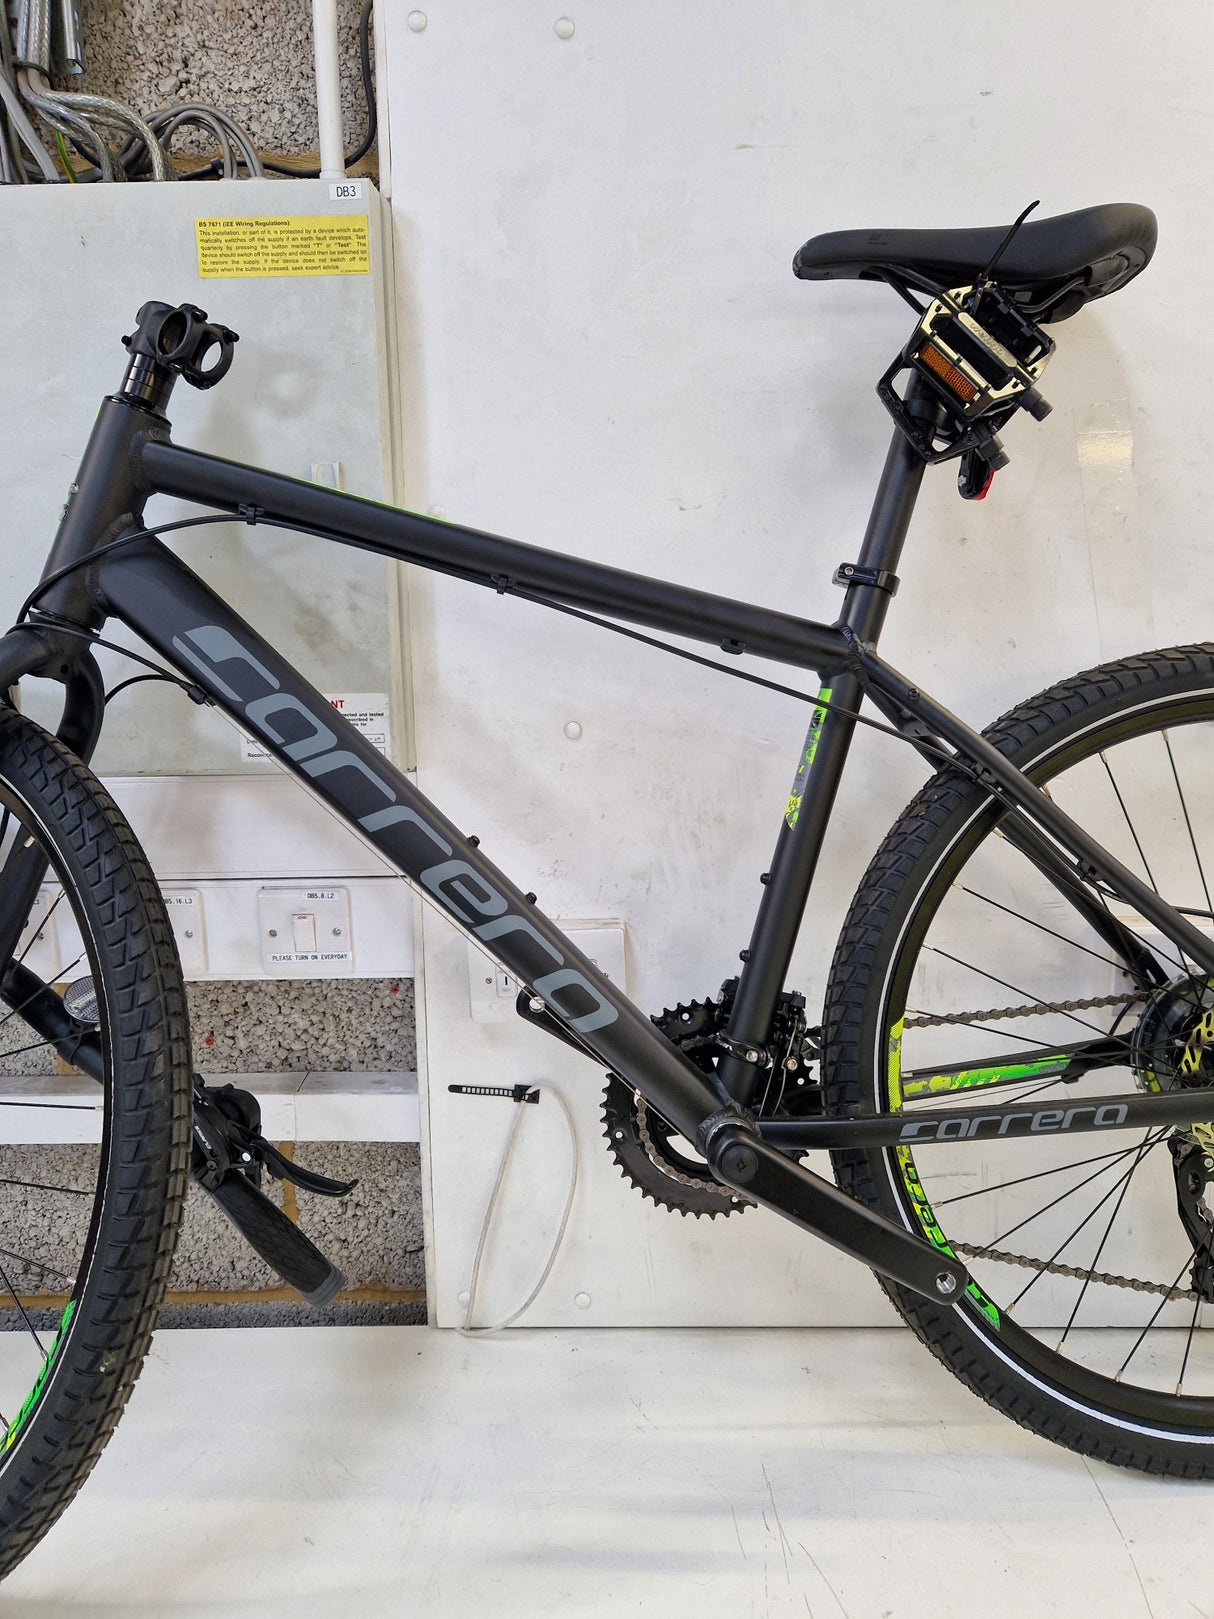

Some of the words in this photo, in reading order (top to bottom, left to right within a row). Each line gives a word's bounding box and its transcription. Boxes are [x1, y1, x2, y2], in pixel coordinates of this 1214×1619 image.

[336, 186, 356, 197] DB3
[172, 625, 618, 1033] carrera
[898, 1104, 1128, 1142] carrera
[904, 1161, 993, 1309] crera
